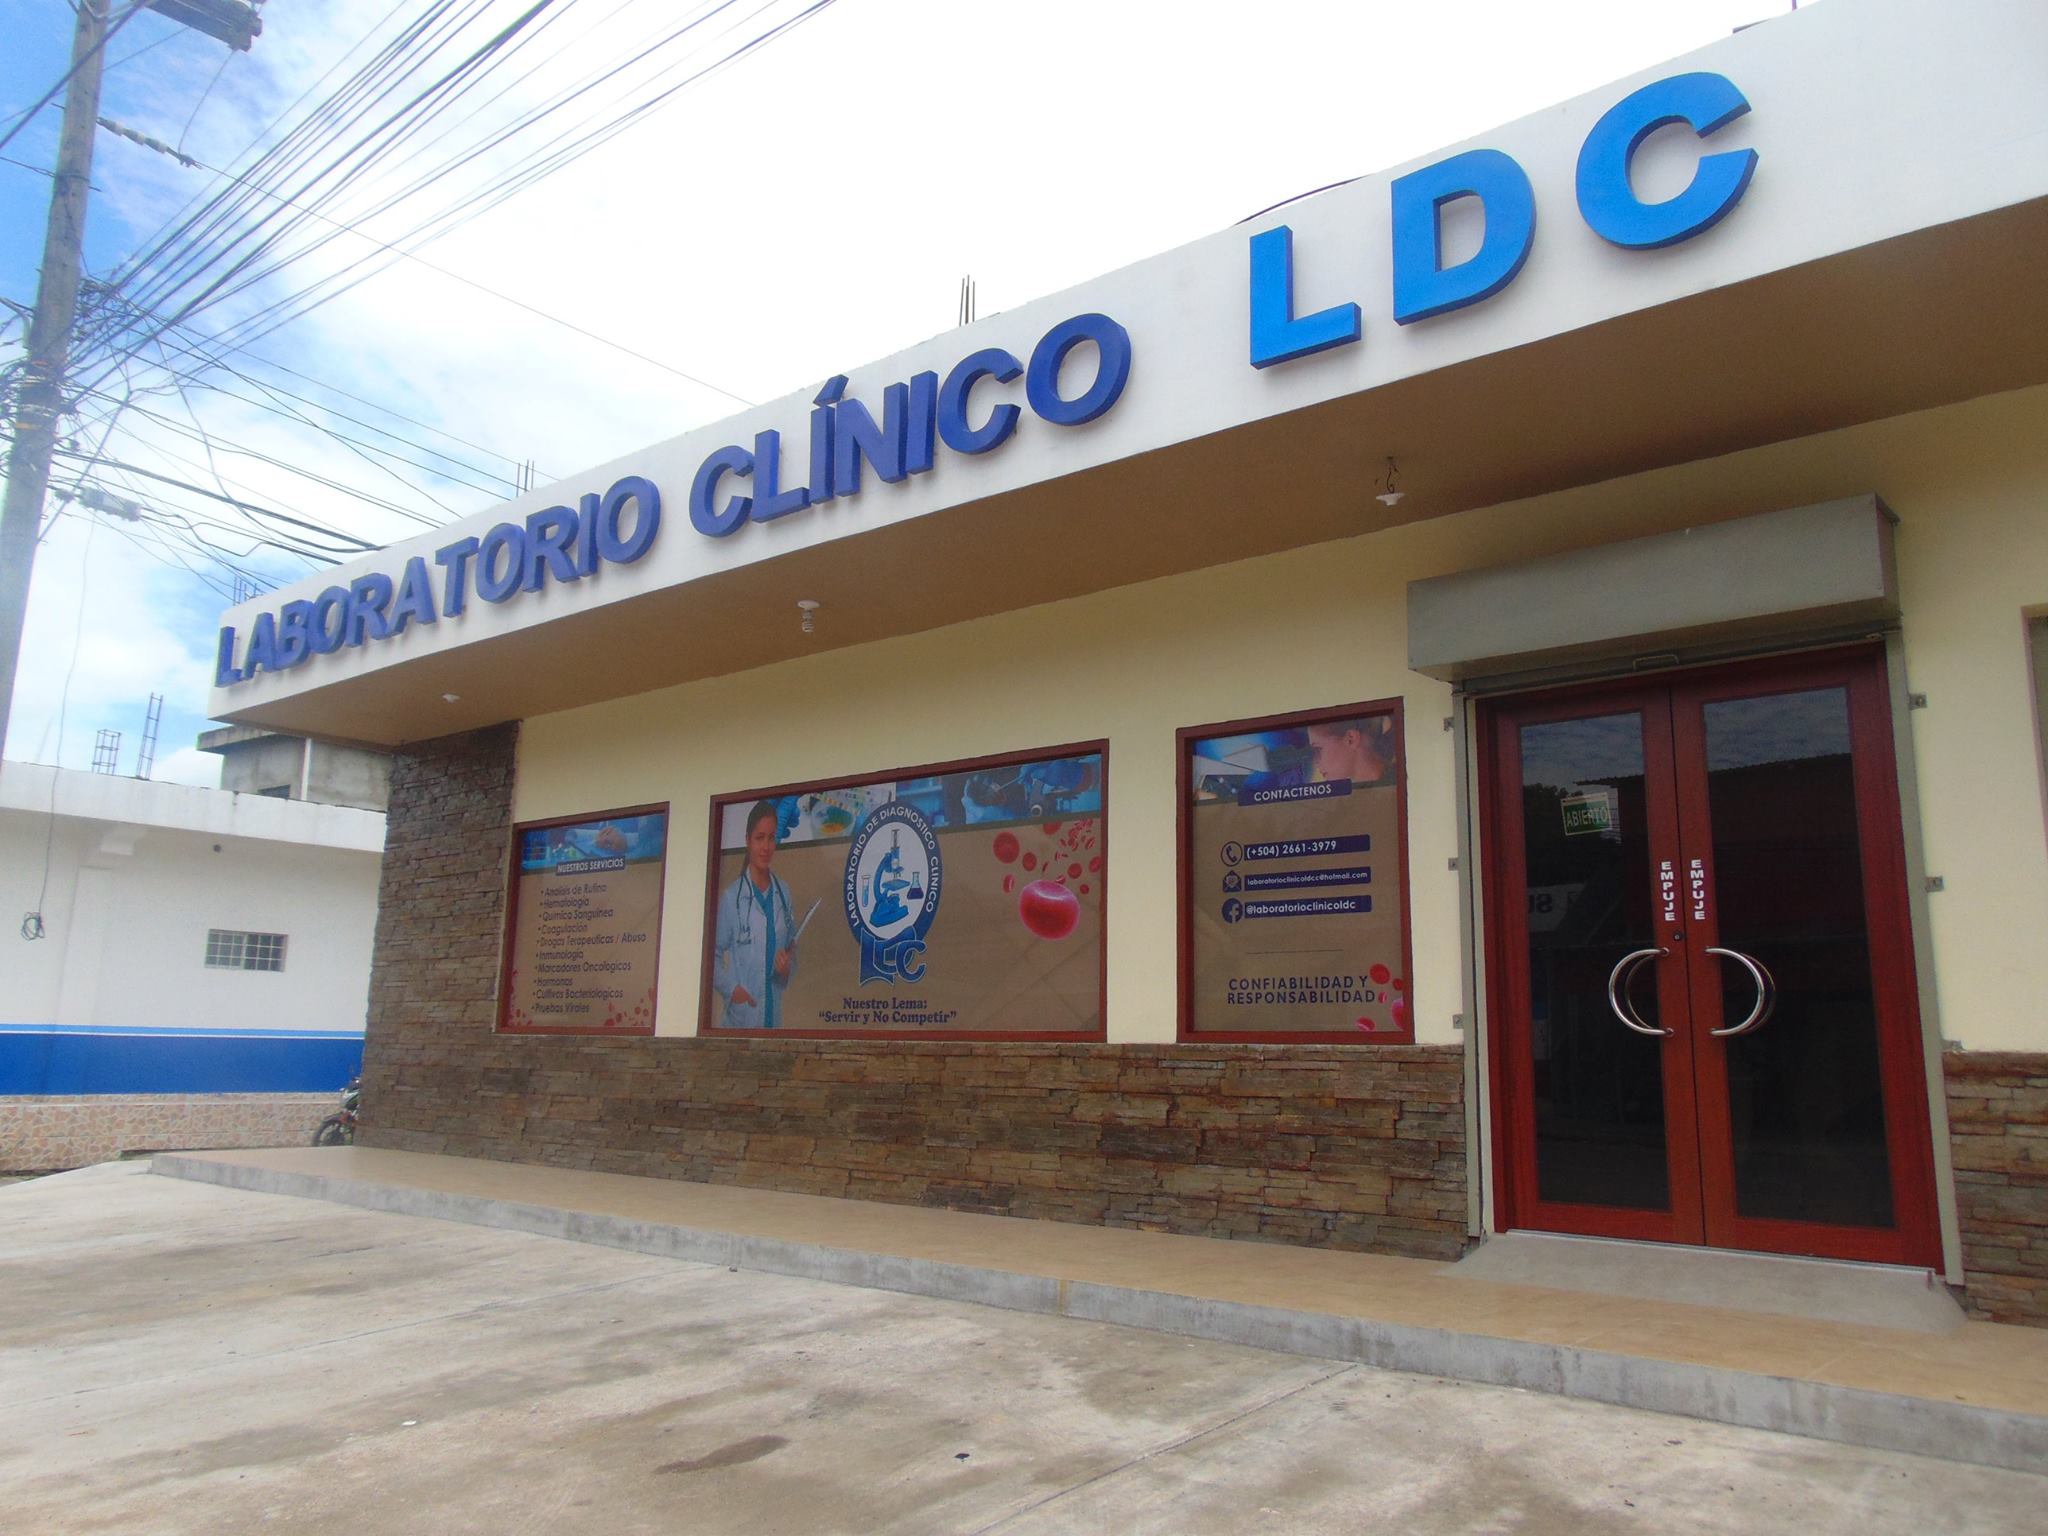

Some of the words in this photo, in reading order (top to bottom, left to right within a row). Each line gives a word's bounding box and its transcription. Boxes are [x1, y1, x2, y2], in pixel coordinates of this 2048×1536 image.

[214, 475, 661, 687] LABORATORIO
[689, 313, 1131, 538] CLÍNICO
[1254, 784, 1332, 801] CONTACTENOS
[1566, 806, 1607, 826] ABIERTO
[1247, 845, 1280, 859] (+504)
[1282, 840, 1337, 854] 2661-3979
[557, 862, 589, 873] NUESTROS
[590, 858, 624, 870] SERVICIOS
[847, 833, 867, 927] LABORATORIO
[867, 817, 879, 832] DE
[880, 806, 936, 851] DIAGNOSTICO
[926, 856, 939, 913] CLINICO
[572, 885, 582, 895] de
[1661, 861, 1675, 921] EMPUJE
[1690, 859, 1705, 919] EMPUJE
[540, 937, 565, 949] Drogas
[621, 933, 647, 943] Abuso
[538, 963, 581, 973] Marcadores
[537, 977, 573, 987] Hormonas
[1228, 975, 1354, 990] CONFIABILIDAD
[1359, 975, 1368, 987] Y
[536, 989, 564, 999] Cultivos
[1227, 991, 1375, 1005] RESPONSABILIDAD
[535, 1003, 563, 1013] Pruebas
[565, 1002, 590, 1013] Virales
[843, 997, 889, 1010] Nuestro
[892, 997, 927, 1010] Lema:
[863, 1013, 870, 1024] y
[873, 1011, 889, 1023] No
